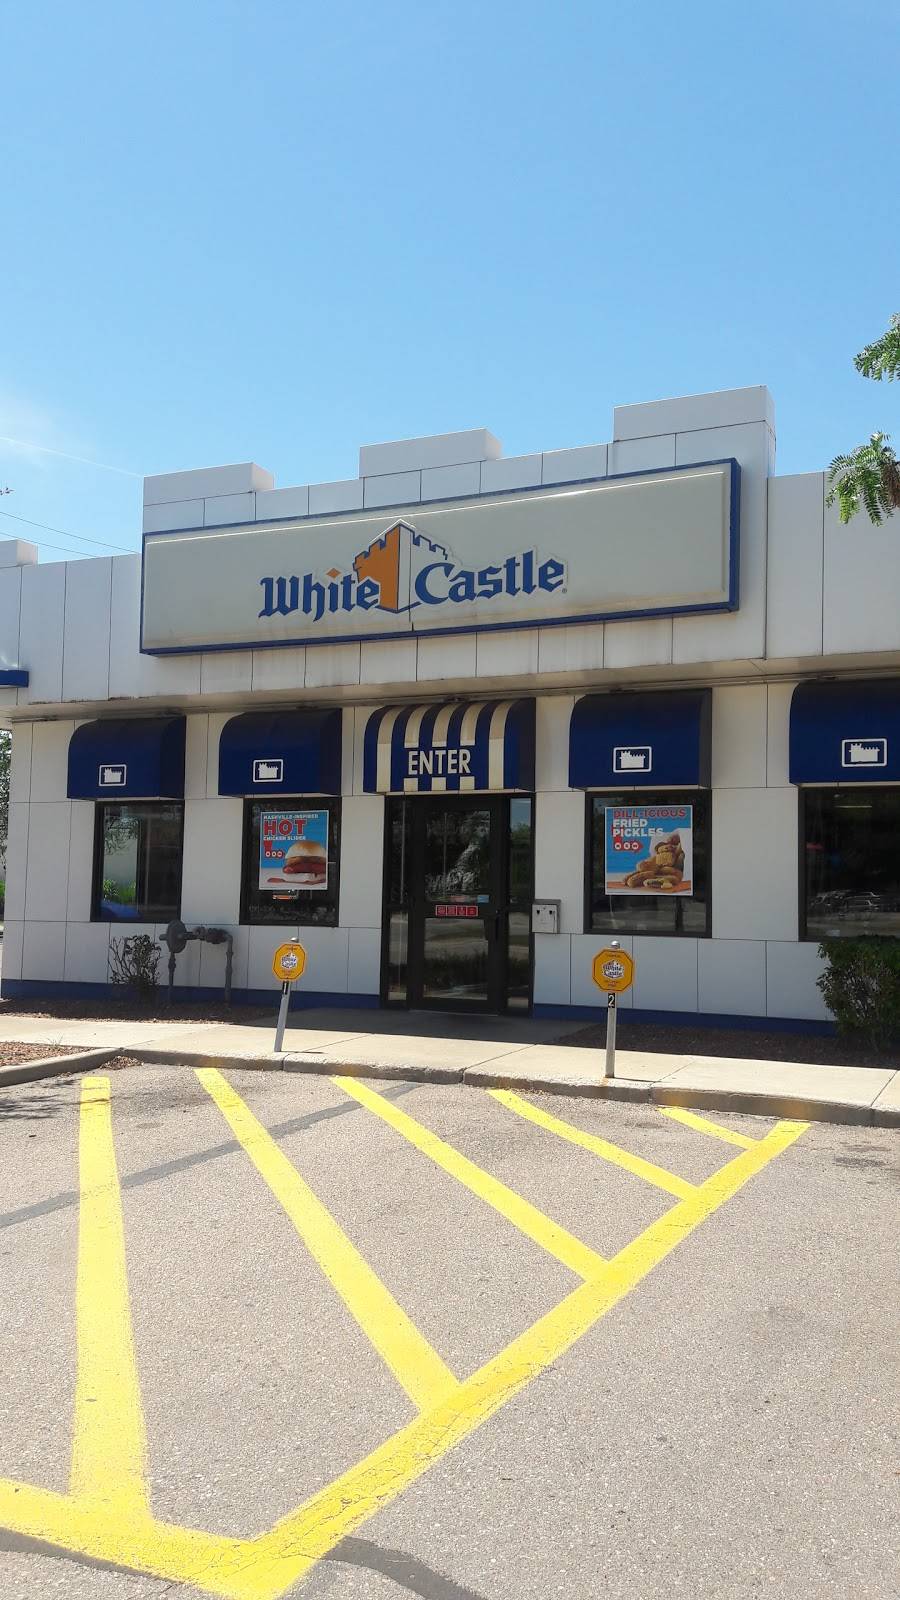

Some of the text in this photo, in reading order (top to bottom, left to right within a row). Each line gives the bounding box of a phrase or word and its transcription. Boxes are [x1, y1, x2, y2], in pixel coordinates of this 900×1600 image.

[258, 550, 565, 622] White Castle
[408, 749, 471, 775] ENTER
[263, 819, 307, 836] HOT
[613, 818, 648, 828] FRIED
[613, 828, 664, 837] PICKLES
[608, 994, 615, 1007] 2
